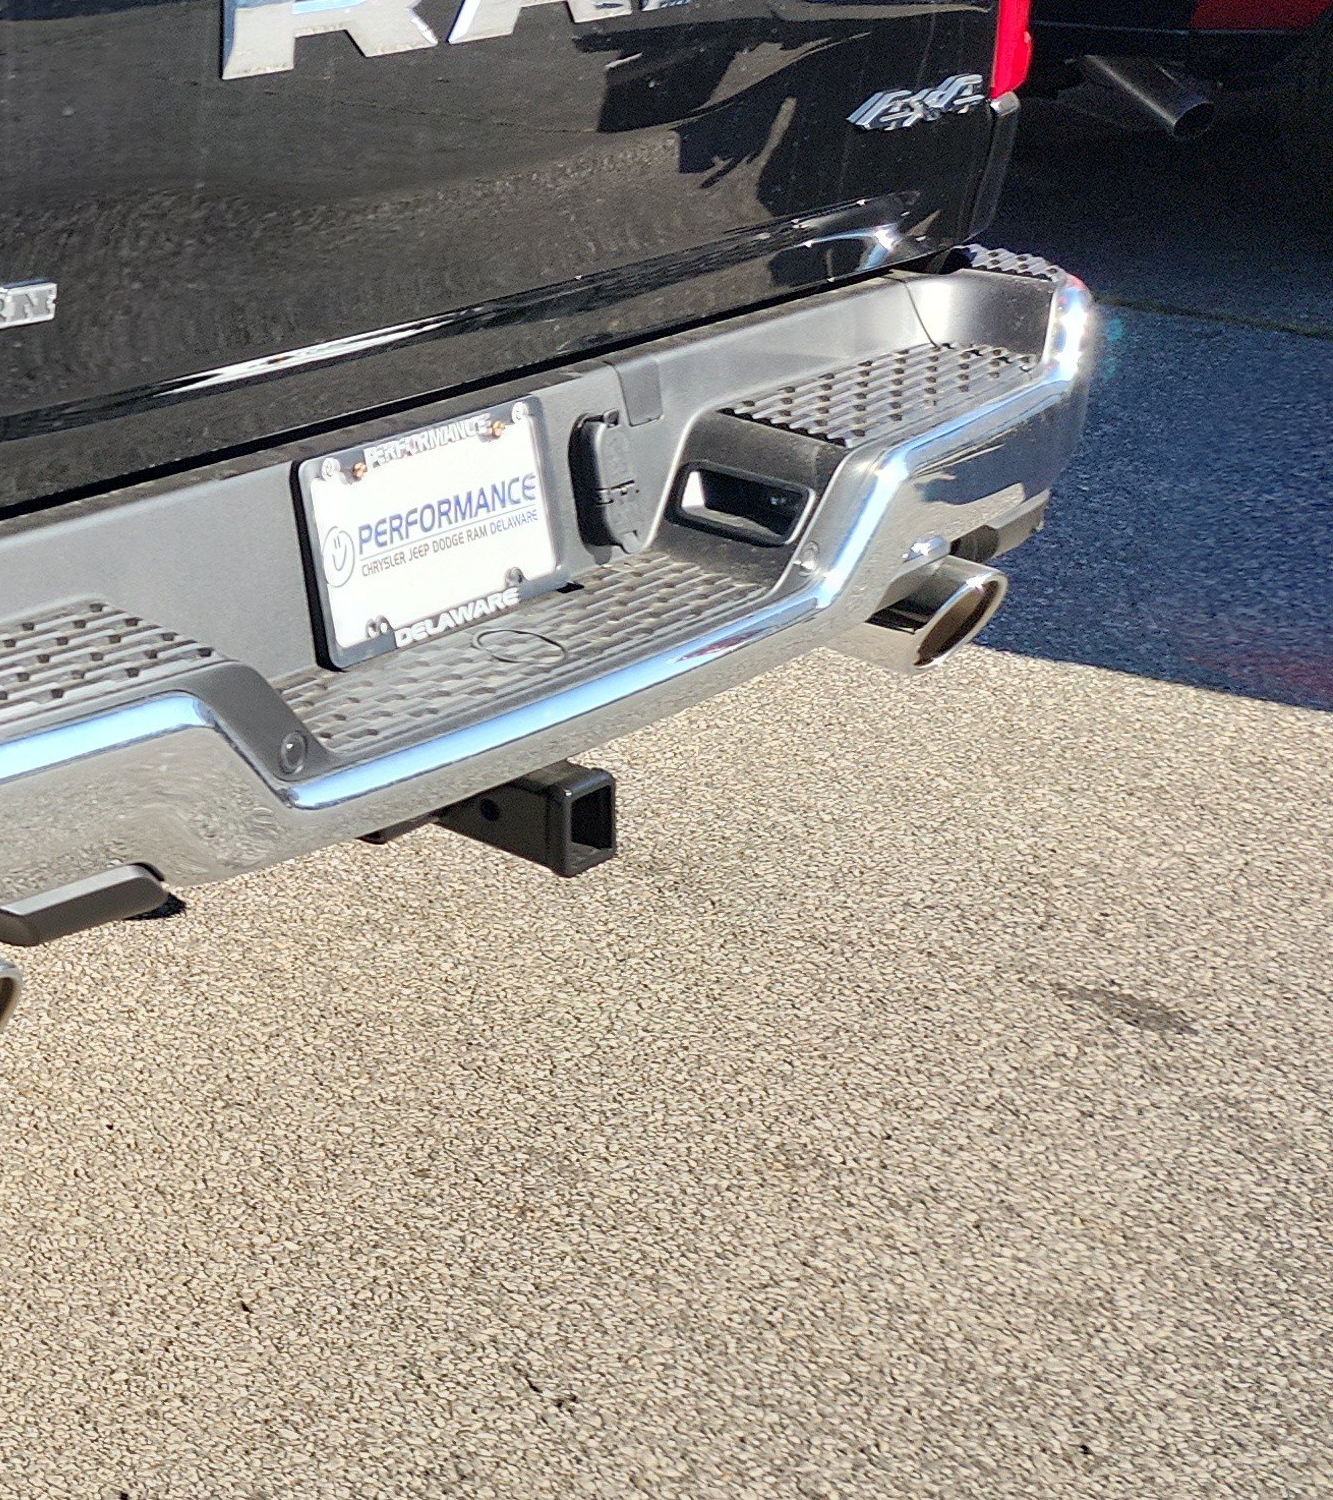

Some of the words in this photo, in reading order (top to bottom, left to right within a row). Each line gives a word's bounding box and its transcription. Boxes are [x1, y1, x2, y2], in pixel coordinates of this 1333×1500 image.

[845, 73, 985, 131] 4x4
[364, 412, 492, 469] PERFORMANCE
[358, 471, 537, 555] PERFORMANCE
[361, 548, 407, 578] CHRYSLER
[408, 544, 430, 563] JEEP
[432, 532, 465, 553] DODGE
[466, 525, 488, 544] RAM
[490, 508, 538, 535] DELAWARE
[394, 586, 520, 648] DELAWARE
